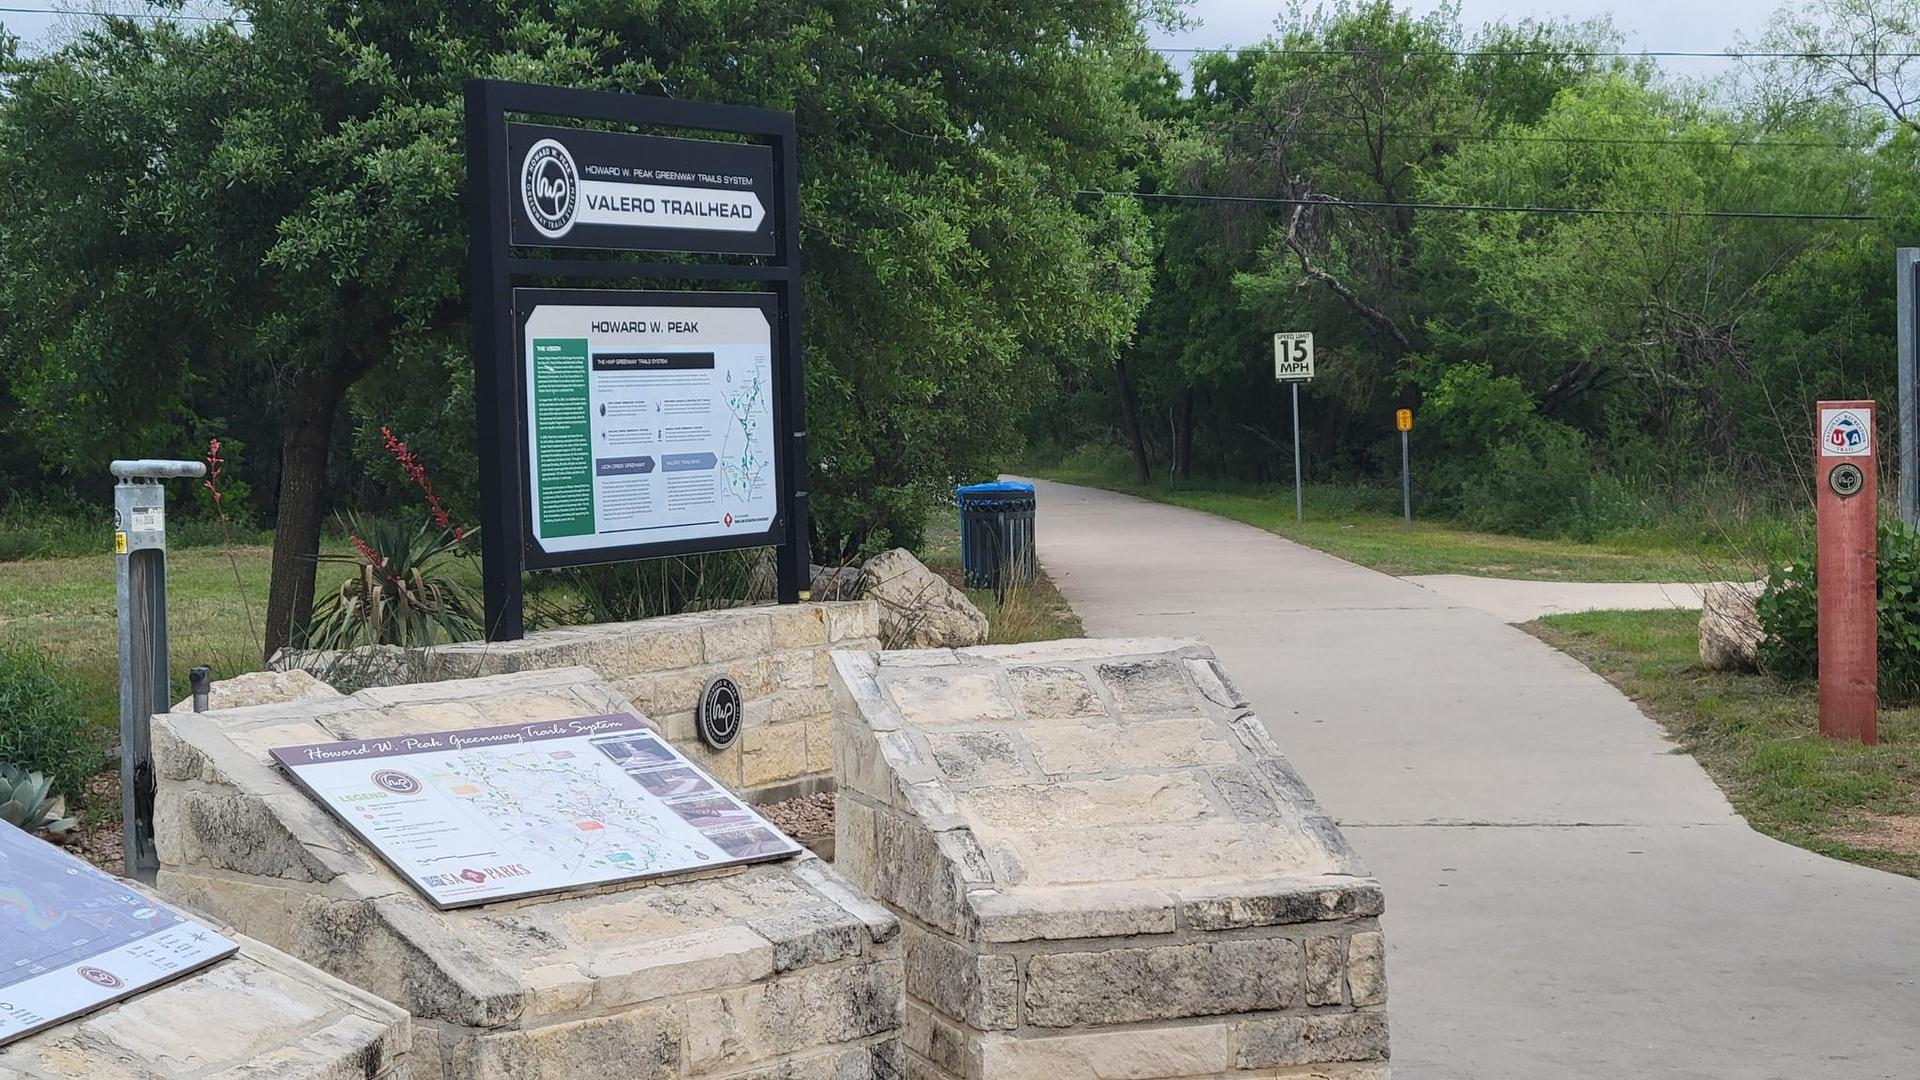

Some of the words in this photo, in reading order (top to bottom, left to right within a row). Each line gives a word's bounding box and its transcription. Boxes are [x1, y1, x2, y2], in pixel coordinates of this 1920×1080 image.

[585, 165, 621, 176] HOWARD
[621, 167, 632, 177] W.
[633, 168, 653, 178] PEAK
[655, 170, 696, 181] GREENWAY
[697, 173, 722, 184] TRAILS
[723, 175, 753, 186] SYSTEM
[586, 194, 656, 214] VALERO
[661, 199, 753, 219] TRAILHEAD
[592, 320, 647, 334] HOWARD
[650, 321, 664, 334] W.
[667, 321, 699, 334] PEAK
[1280, 339, 1308, 363] 15
[1280, 362, 1310, 373] MPH
[303, 744, 371, 761] Howard
[372, 740, 399, 752] W.
[400, 738, 443, 754] Peak
[449, 731, 526, 751] Greenway
[520, 722, 568, 741] Trails
[568, 720, 623, 737] System
[482, 863, 531, 880] PARKS
